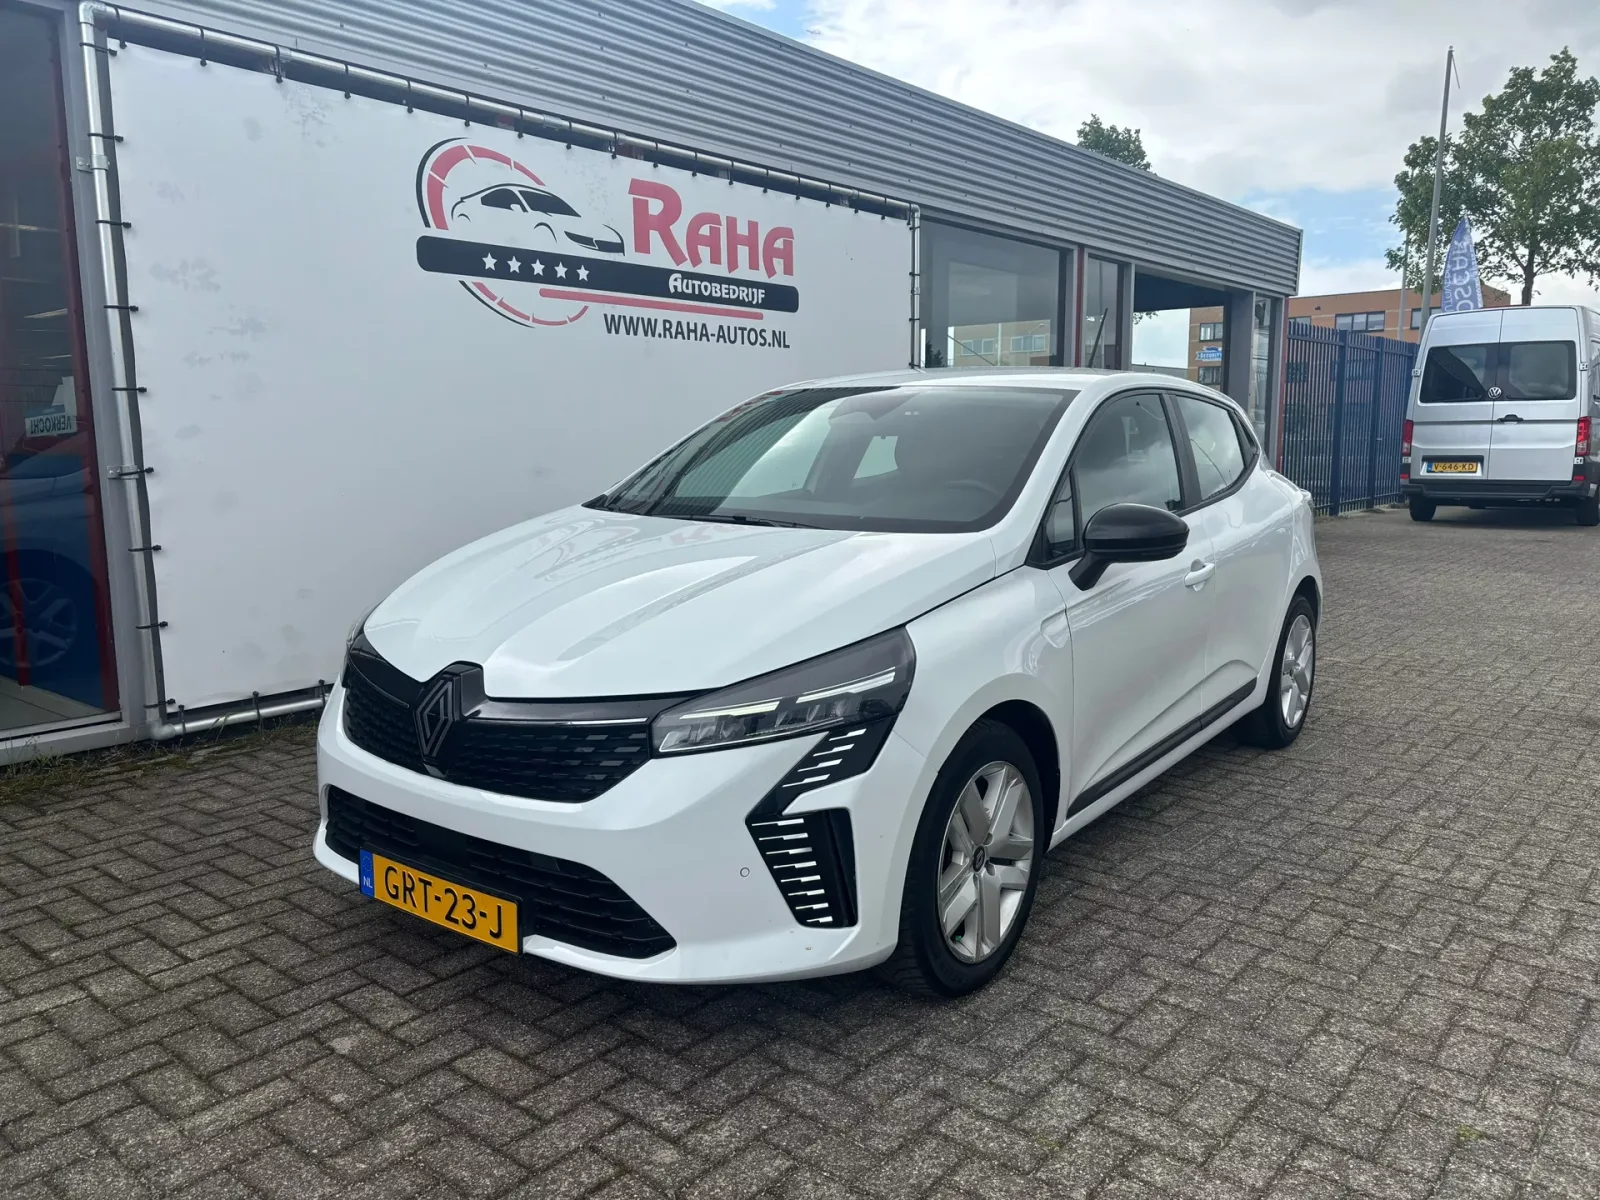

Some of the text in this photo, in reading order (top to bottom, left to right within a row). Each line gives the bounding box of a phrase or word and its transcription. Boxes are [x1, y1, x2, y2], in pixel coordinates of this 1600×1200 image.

[627, 177, 794, 279] RAHA
[668, 272, 766, 305] AUTOBEDRIJF
[603, 313, 791, 350] WWW.RAHA-AUTOS.NL
[30, 414, 72, 434] VERKOCHT
[363, 875, 373, 889] NL
[384, 865, 502, 939] GRT-23-J
